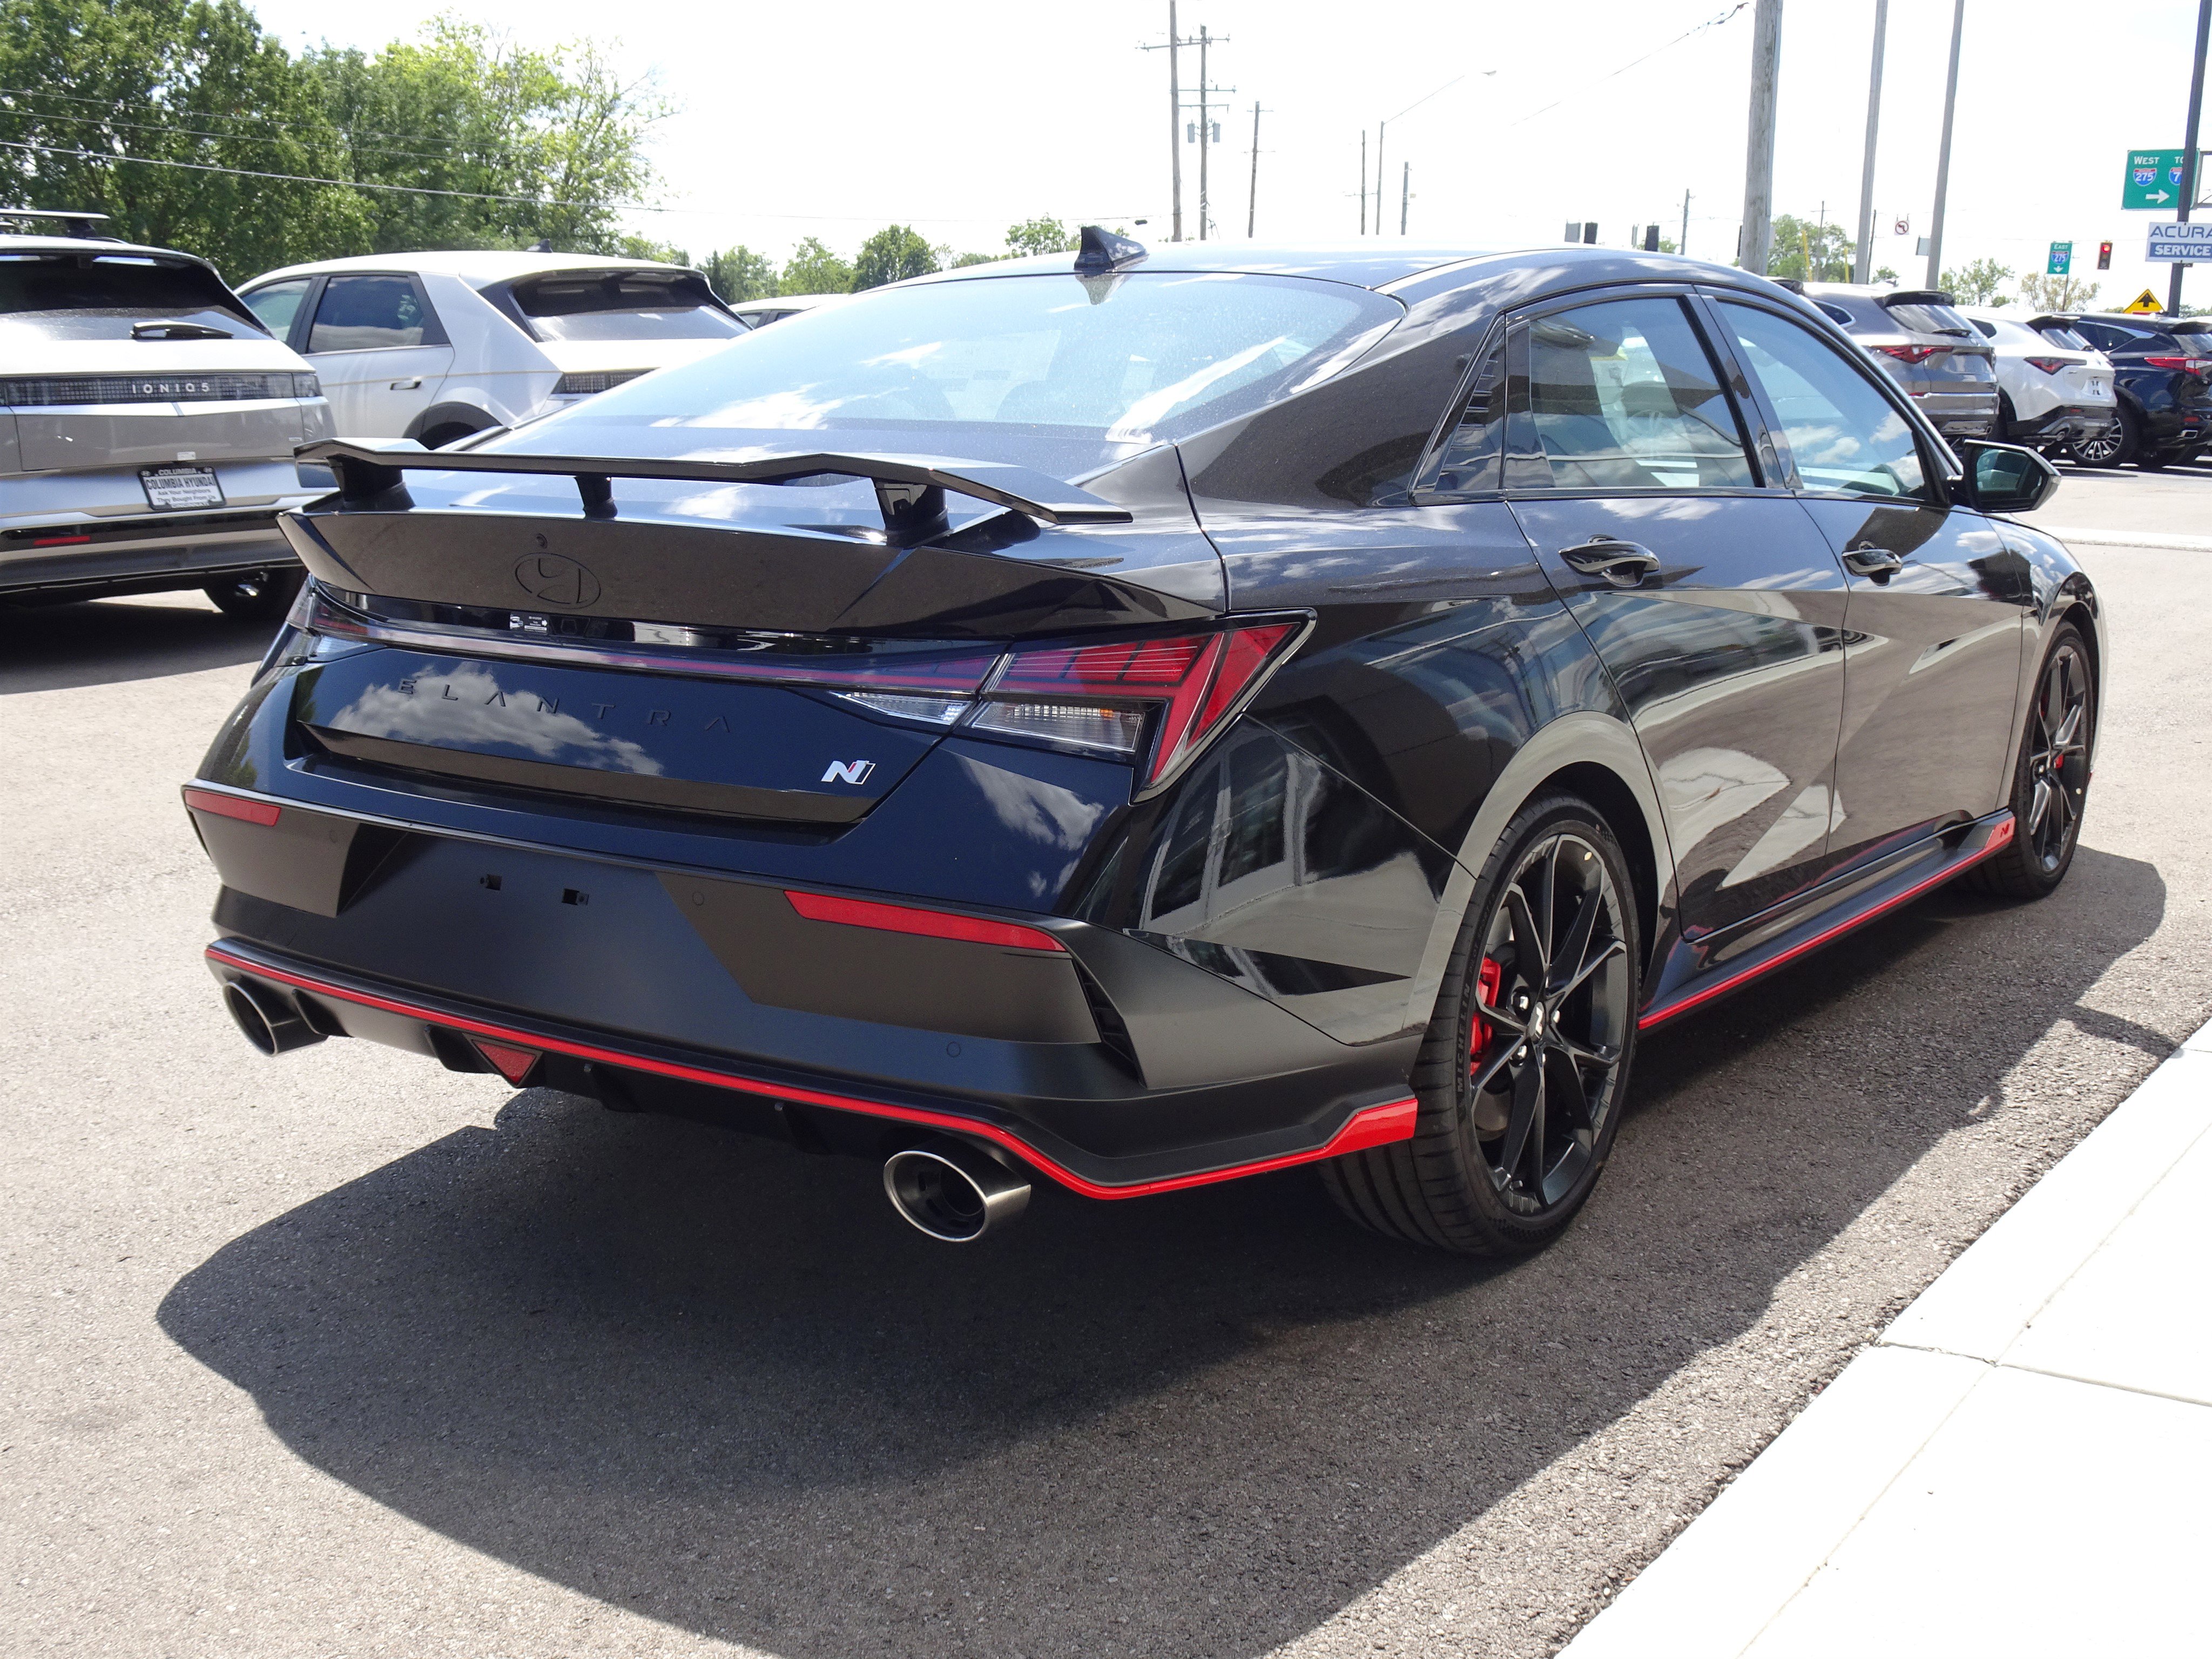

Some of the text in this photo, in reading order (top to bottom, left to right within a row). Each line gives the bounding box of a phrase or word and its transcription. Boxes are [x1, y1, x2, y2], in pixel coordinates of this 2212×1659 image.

[2134, 156, 2160, 165] WEST
[2135, 172, 2154, 181] 275
[2154, 244, 2211, 256] SERVICE
[2054, 254, 2066, 262] 275
[145, 476, 216, 490] COLUMBIA HYUNDAI
[398, 677, 730, 733] ELANTRA
[821, 759, 876, 785] N
[1458, 983, 1471, 1092] MICHELIN
